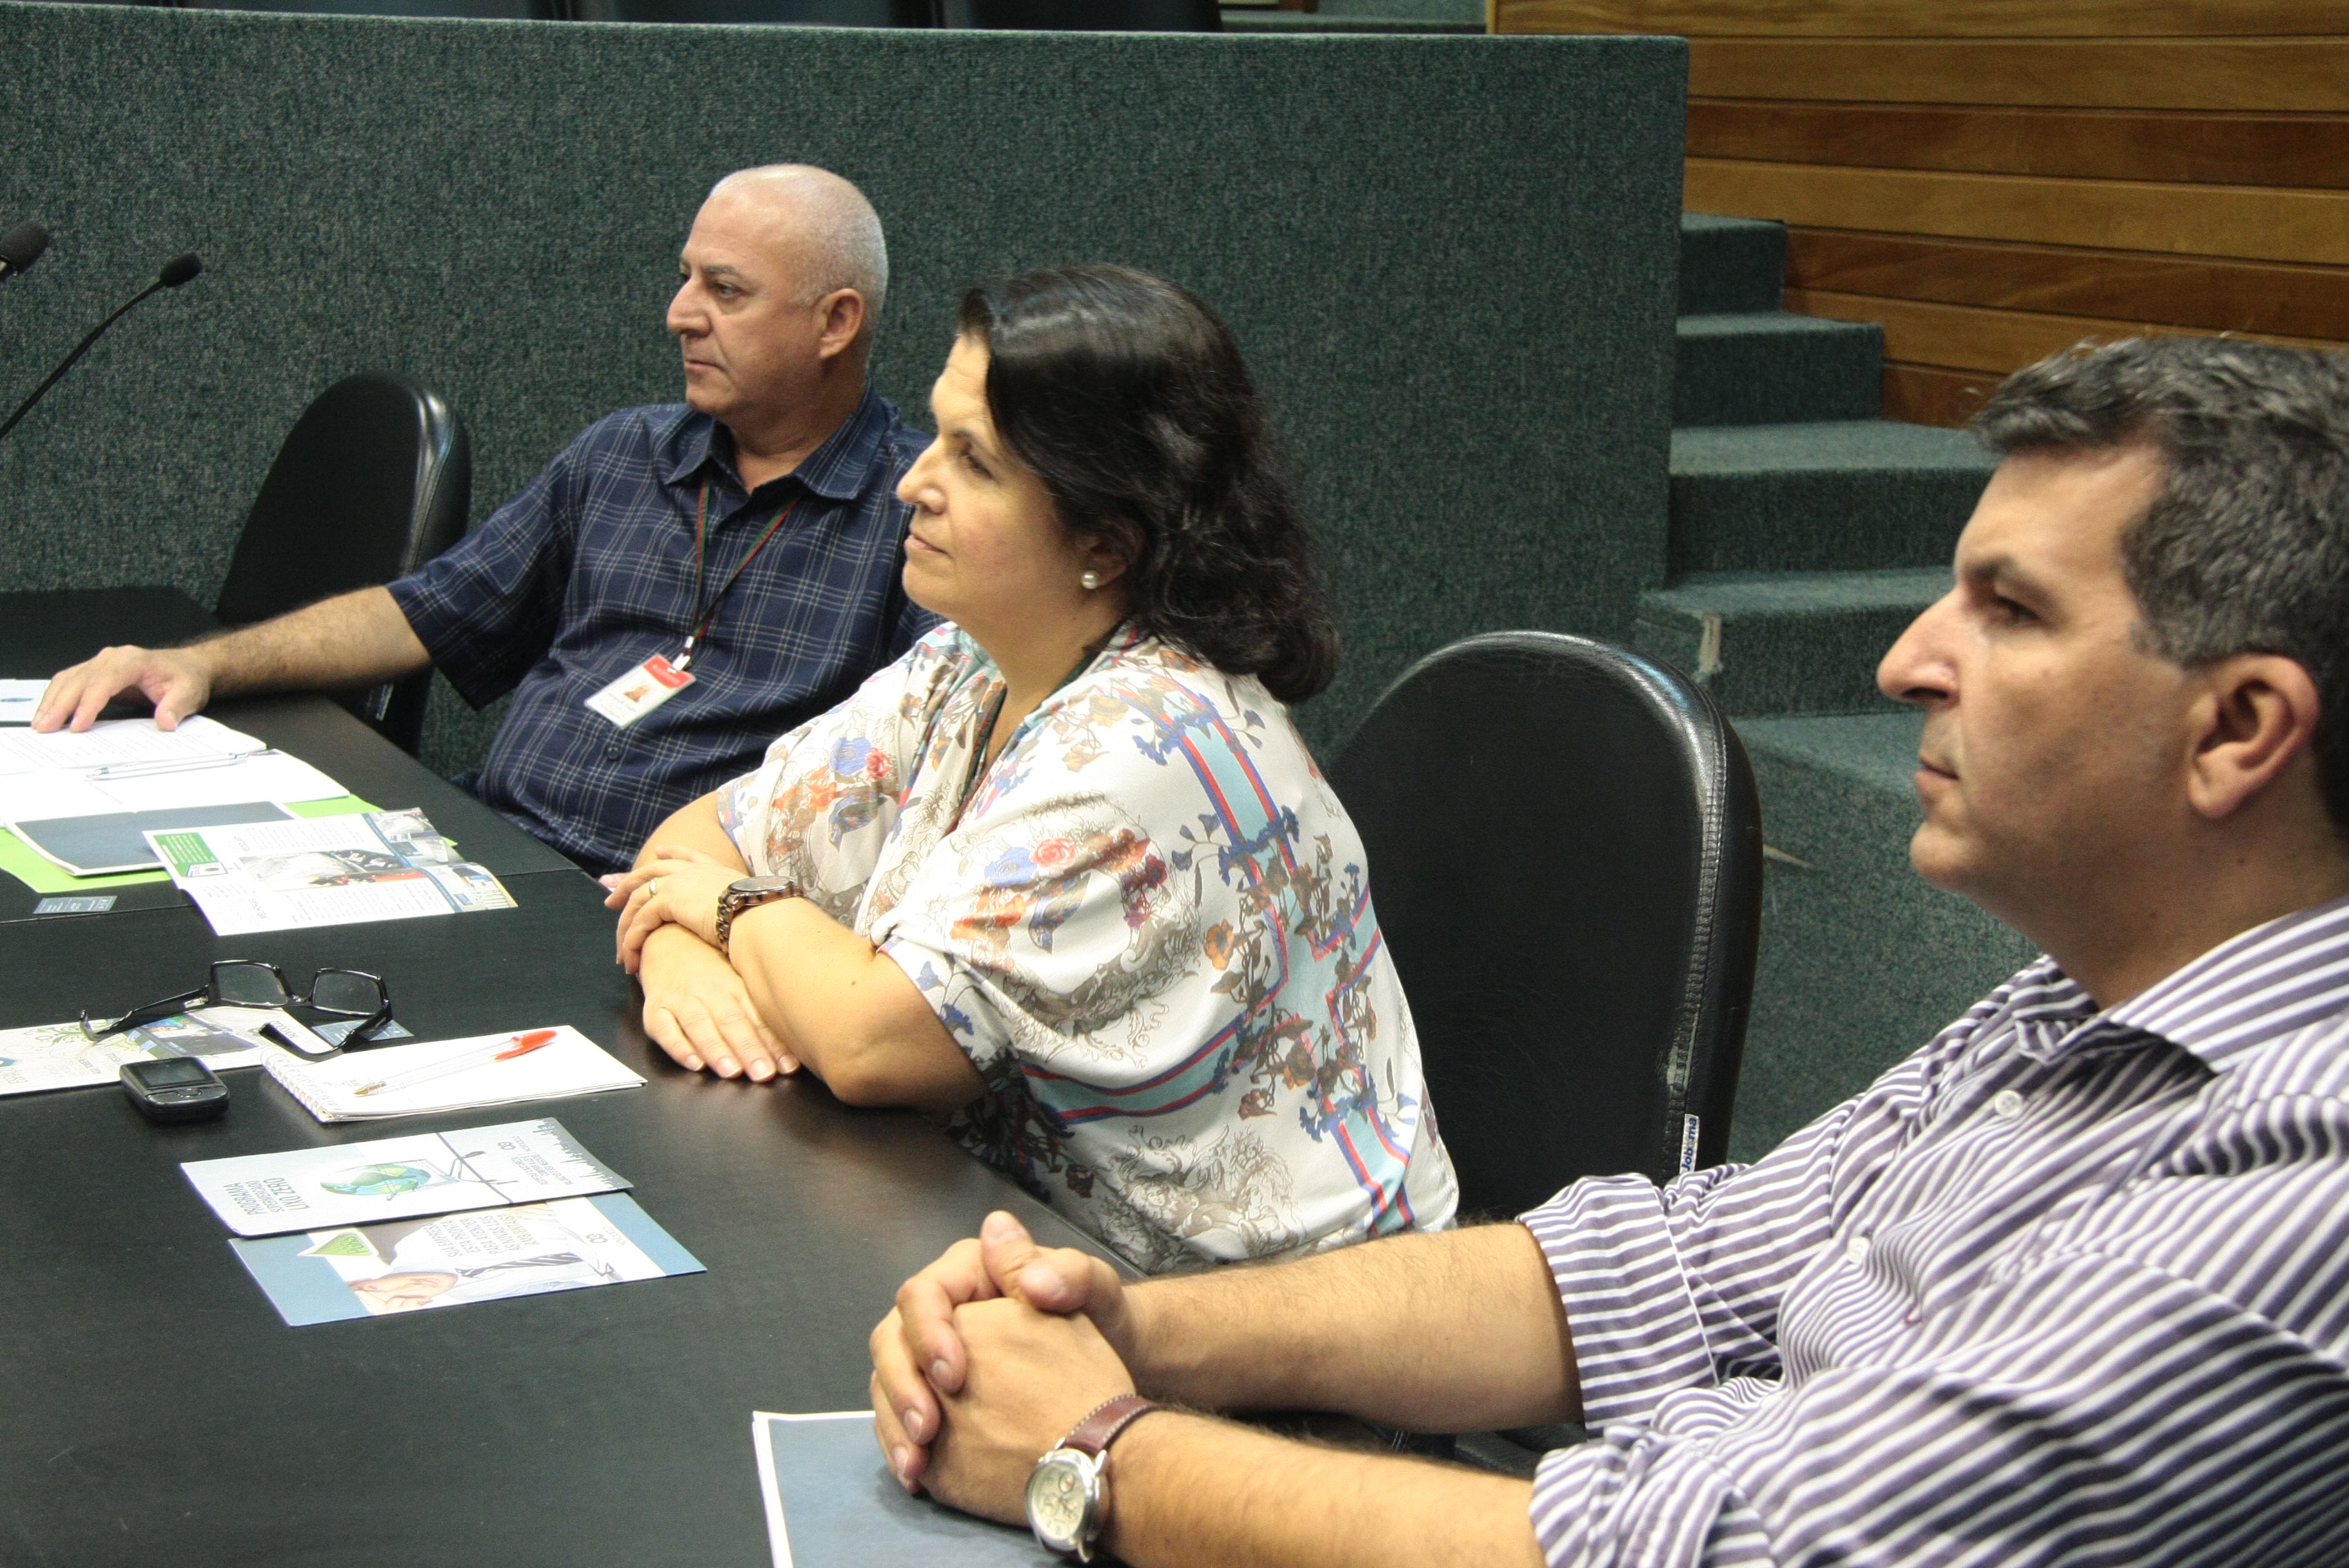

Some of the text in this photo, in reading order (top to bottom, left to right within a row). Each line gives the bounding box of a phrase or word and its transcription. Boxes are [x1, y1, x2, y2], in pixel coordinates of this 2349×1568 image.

[223, 1183, 265, 1214] PROGRAMA
[245, 1180, 284, 1212] SUPERMERCADO
[263, 1178, 309, 1210] LIXO ZERO
[458, 1217, 504, 1254] PARA ATENDER
[477, 1214, 500, 1226] LEIS
[487, 1226, 516, 1244] NOVAS
[498, 1214, 539, 1245] AMBIENTAIS?
[340, 1234, 368, 1254] PGRS
[420, 1222, 464, 1257] SUA EMPRESA
[439, 1219, 482, 1253] ESTÁ PRONTA
